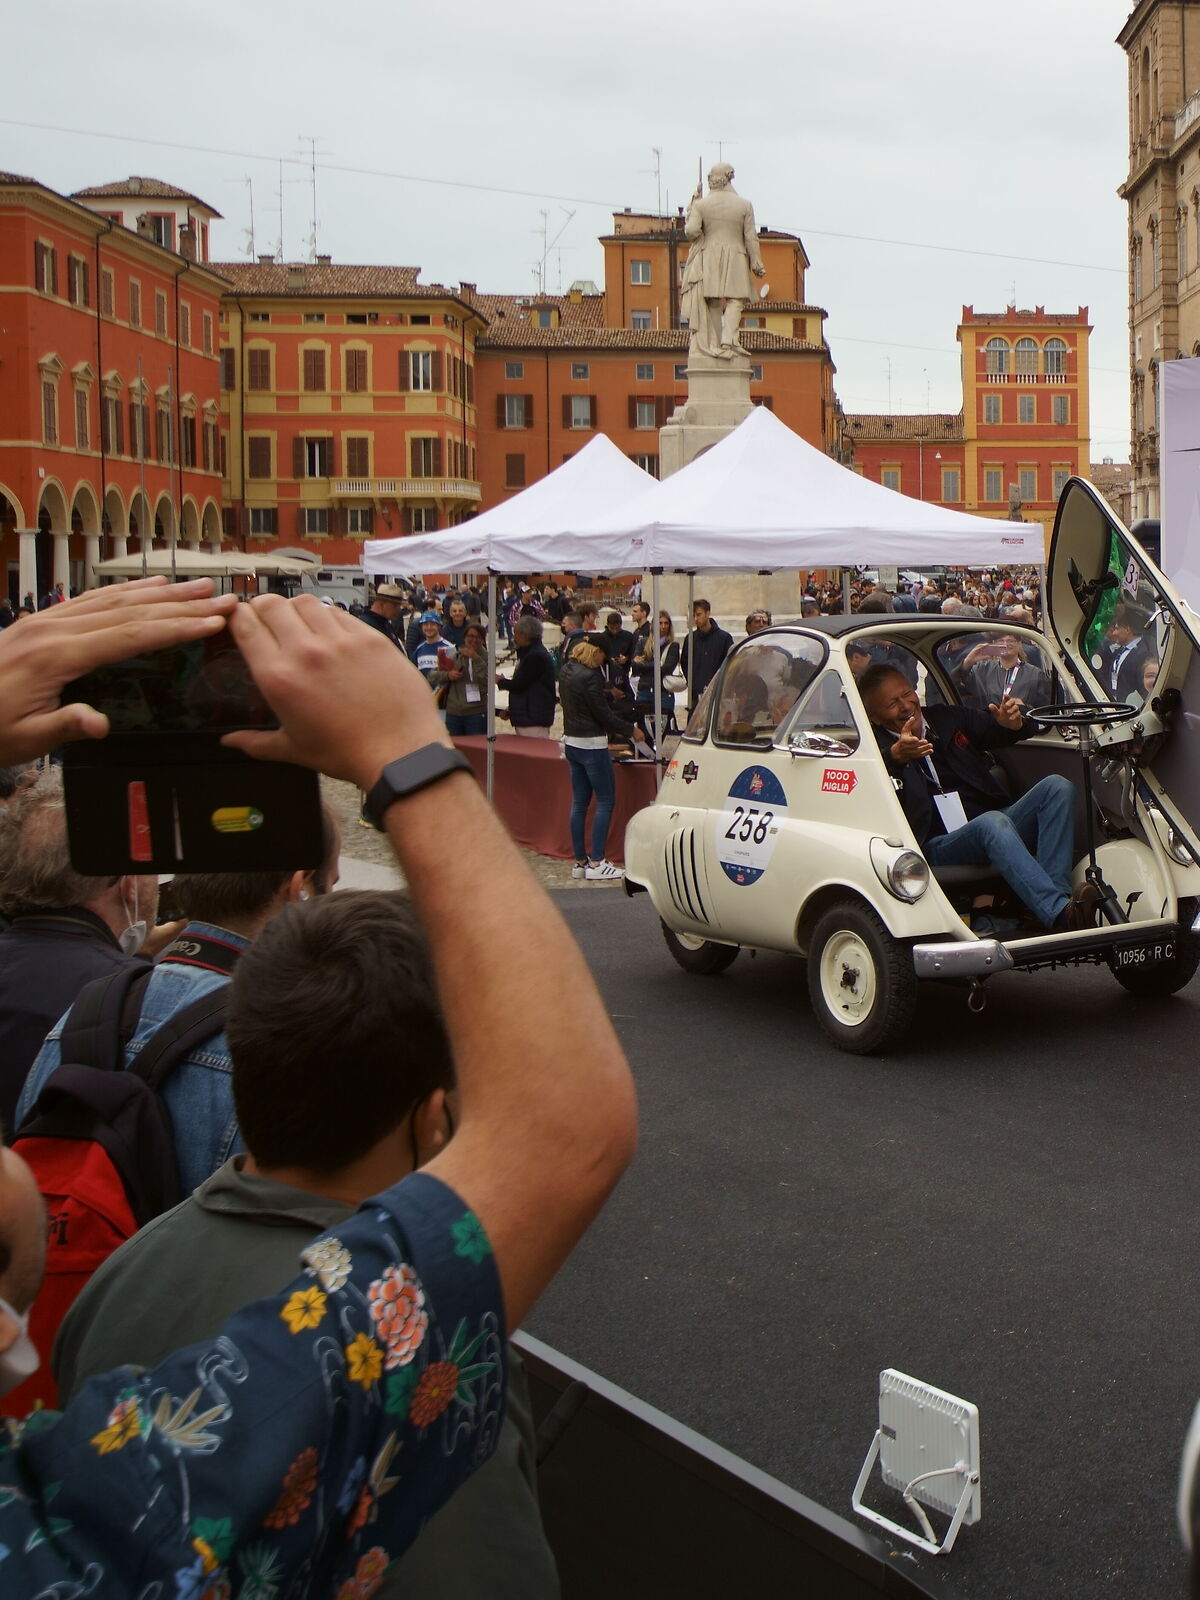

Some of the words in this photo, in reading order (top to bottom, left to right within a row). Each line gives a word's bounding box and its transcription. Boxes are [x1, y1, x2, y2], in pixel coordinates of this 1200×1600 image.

[826, 771, 850, 781] 1000
[823, 782, 849, 792] MIGLIA
[725, 806, 774, 845] 258
[1119, 947, 1146, 966] 10956
